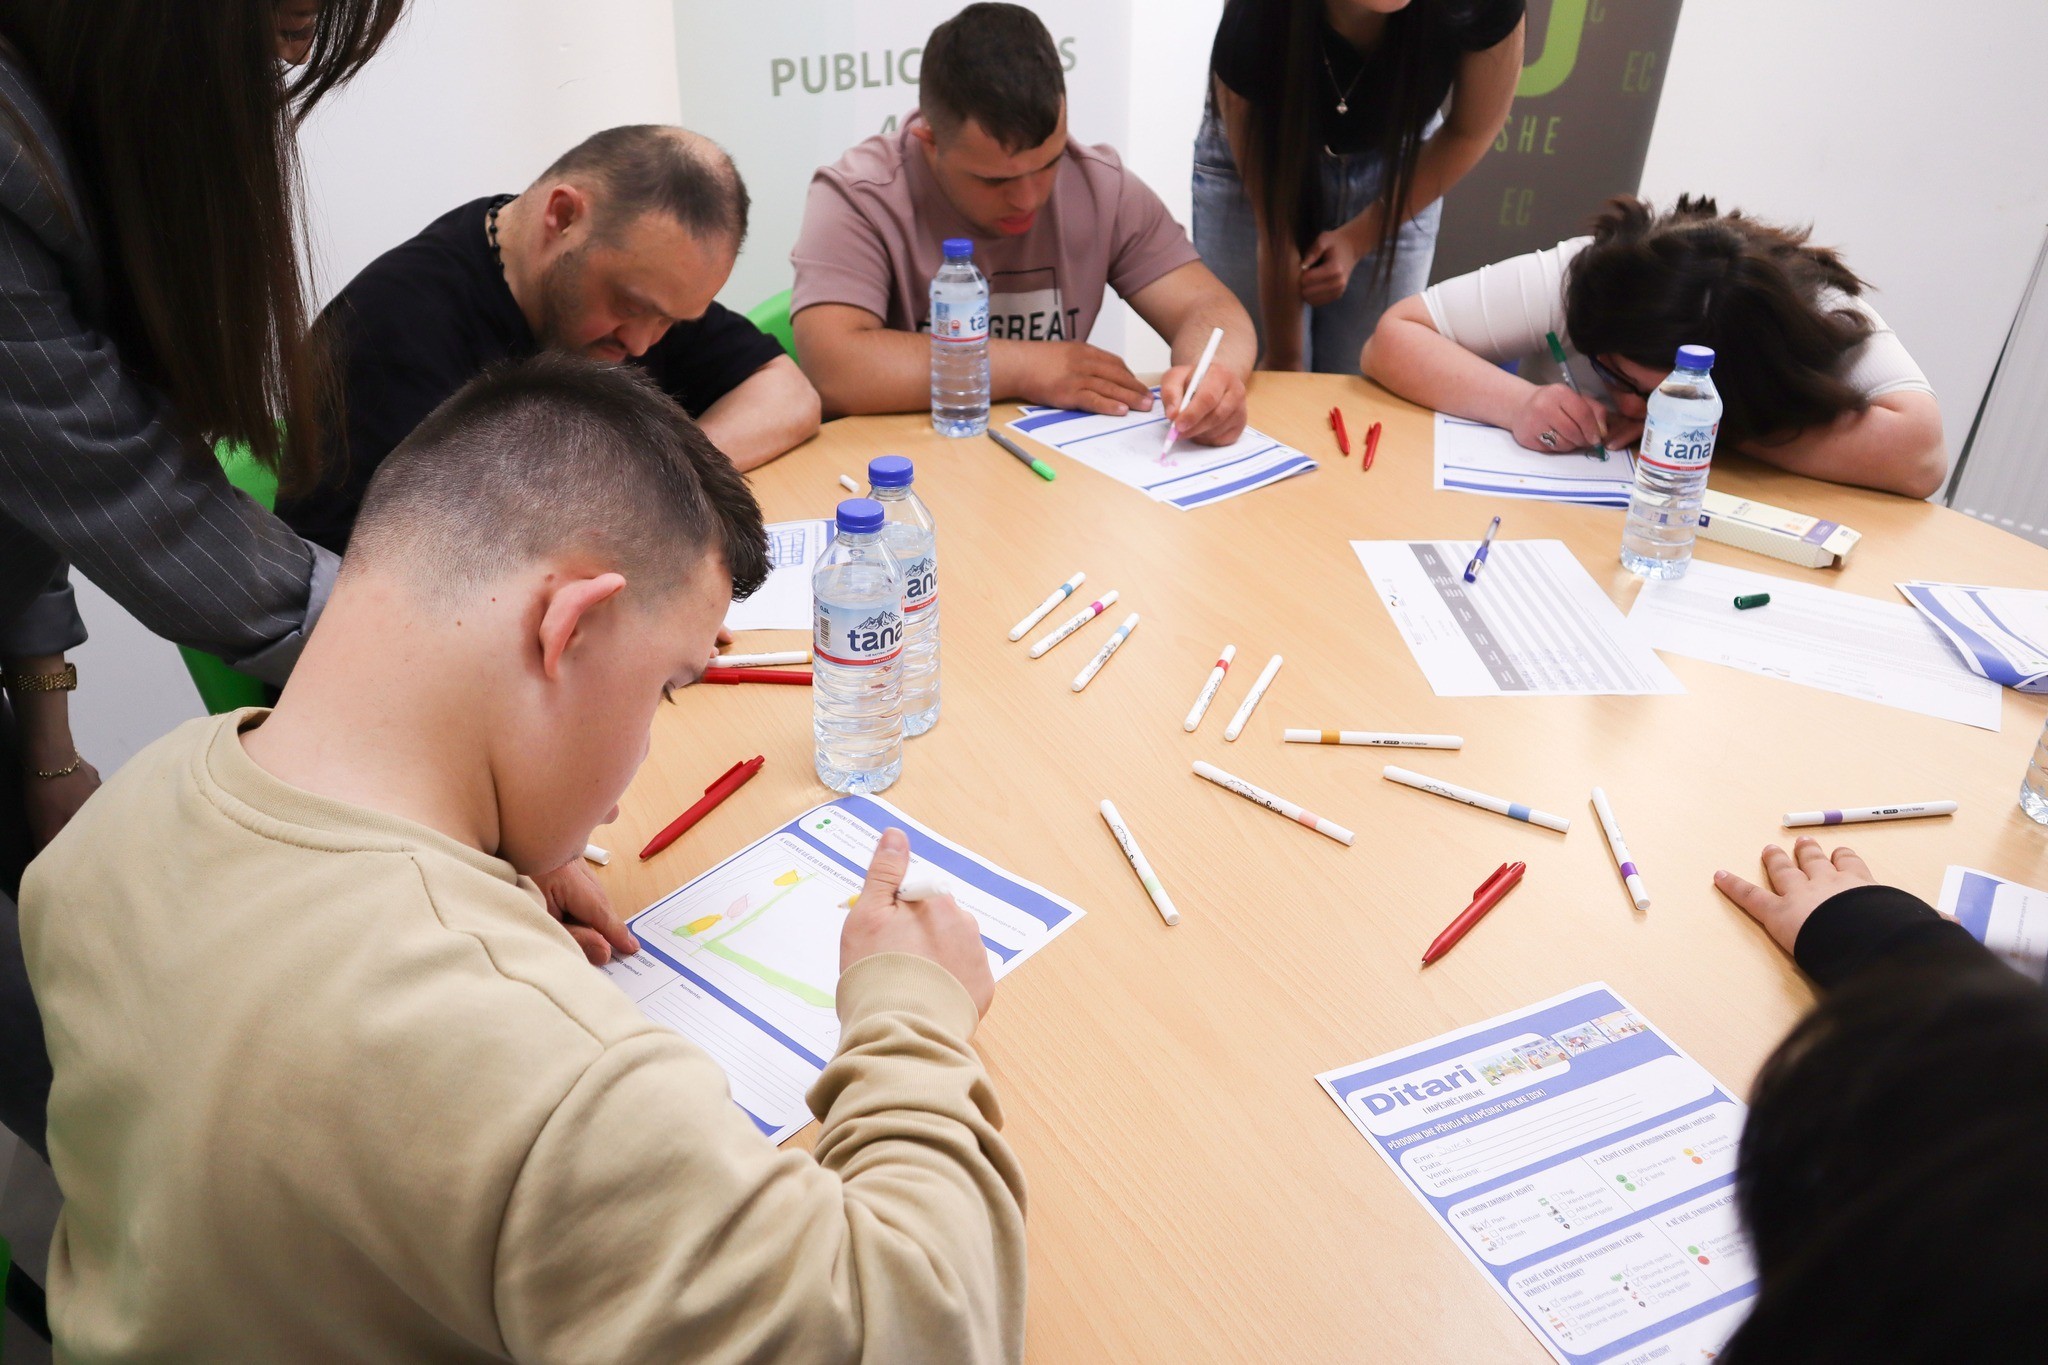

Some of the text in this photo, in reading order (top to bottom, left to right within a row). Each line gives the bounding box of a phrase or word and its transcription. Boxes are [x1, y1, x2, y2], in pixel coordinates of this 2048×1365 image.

[989, 307, 1079, 341] GREAT
[1664, 439, 1711, 460] tana
[847, 621, 902, 651] tana
[1361, 1064, 1477, 1116] Ditari
[1422, 1126, 1437, 1138] DHE
